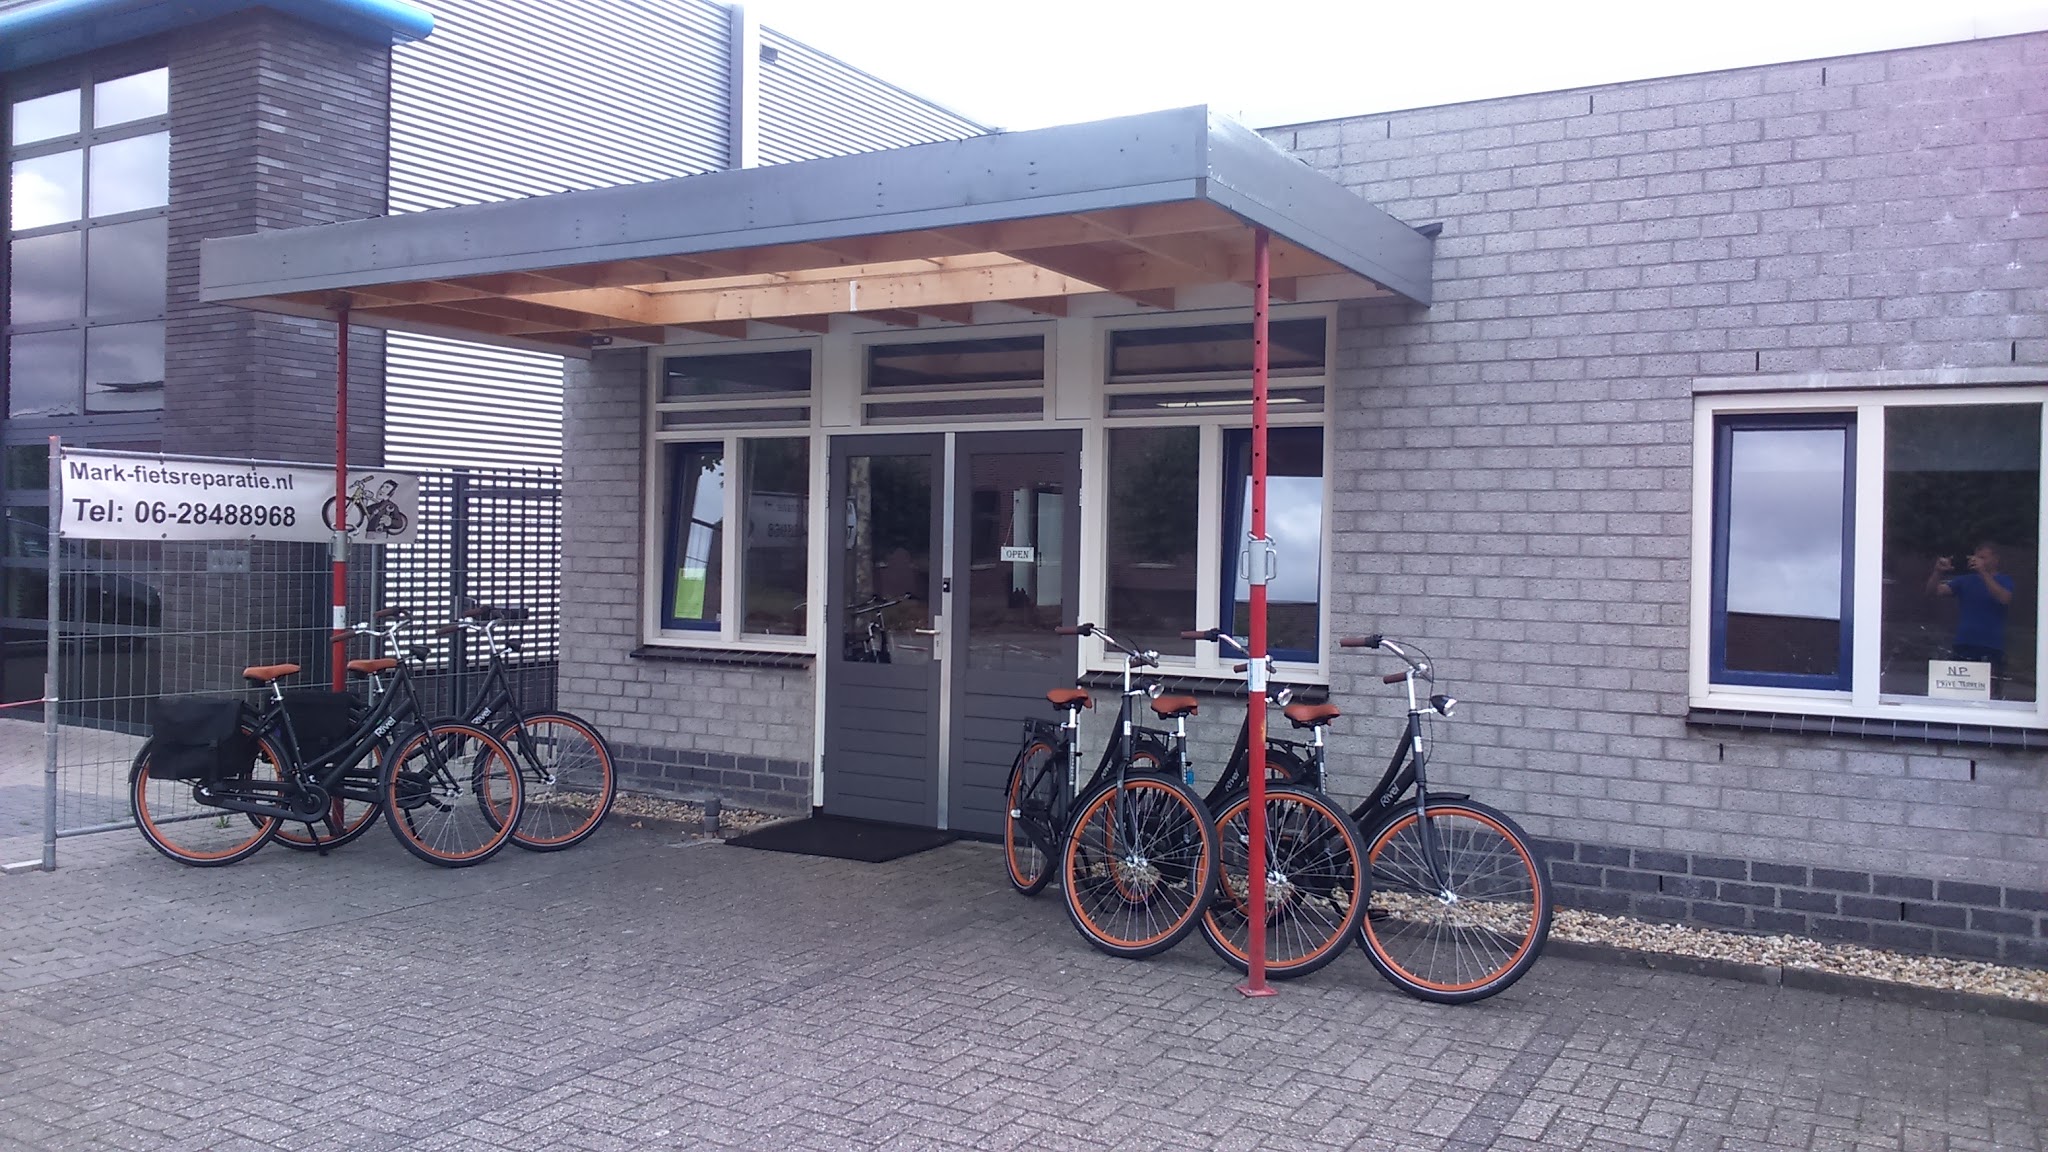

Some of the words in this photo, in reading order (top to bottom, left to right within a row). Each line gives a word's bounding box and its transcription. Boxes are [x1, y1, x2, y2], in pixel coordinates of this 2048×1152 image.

[69, 461, 294, 491] Mark-fietsreparatie.nl
[72, 498, 123, 523] Tel:
[134, 500, 296, 527] 06-28488968
[1005, 549, 1030, 560] OPEN
[374, 716, 397, 738] Rivel
[470, 707, 492, 725] Rivel
[1380, 782, 1401, 808] Rivel
